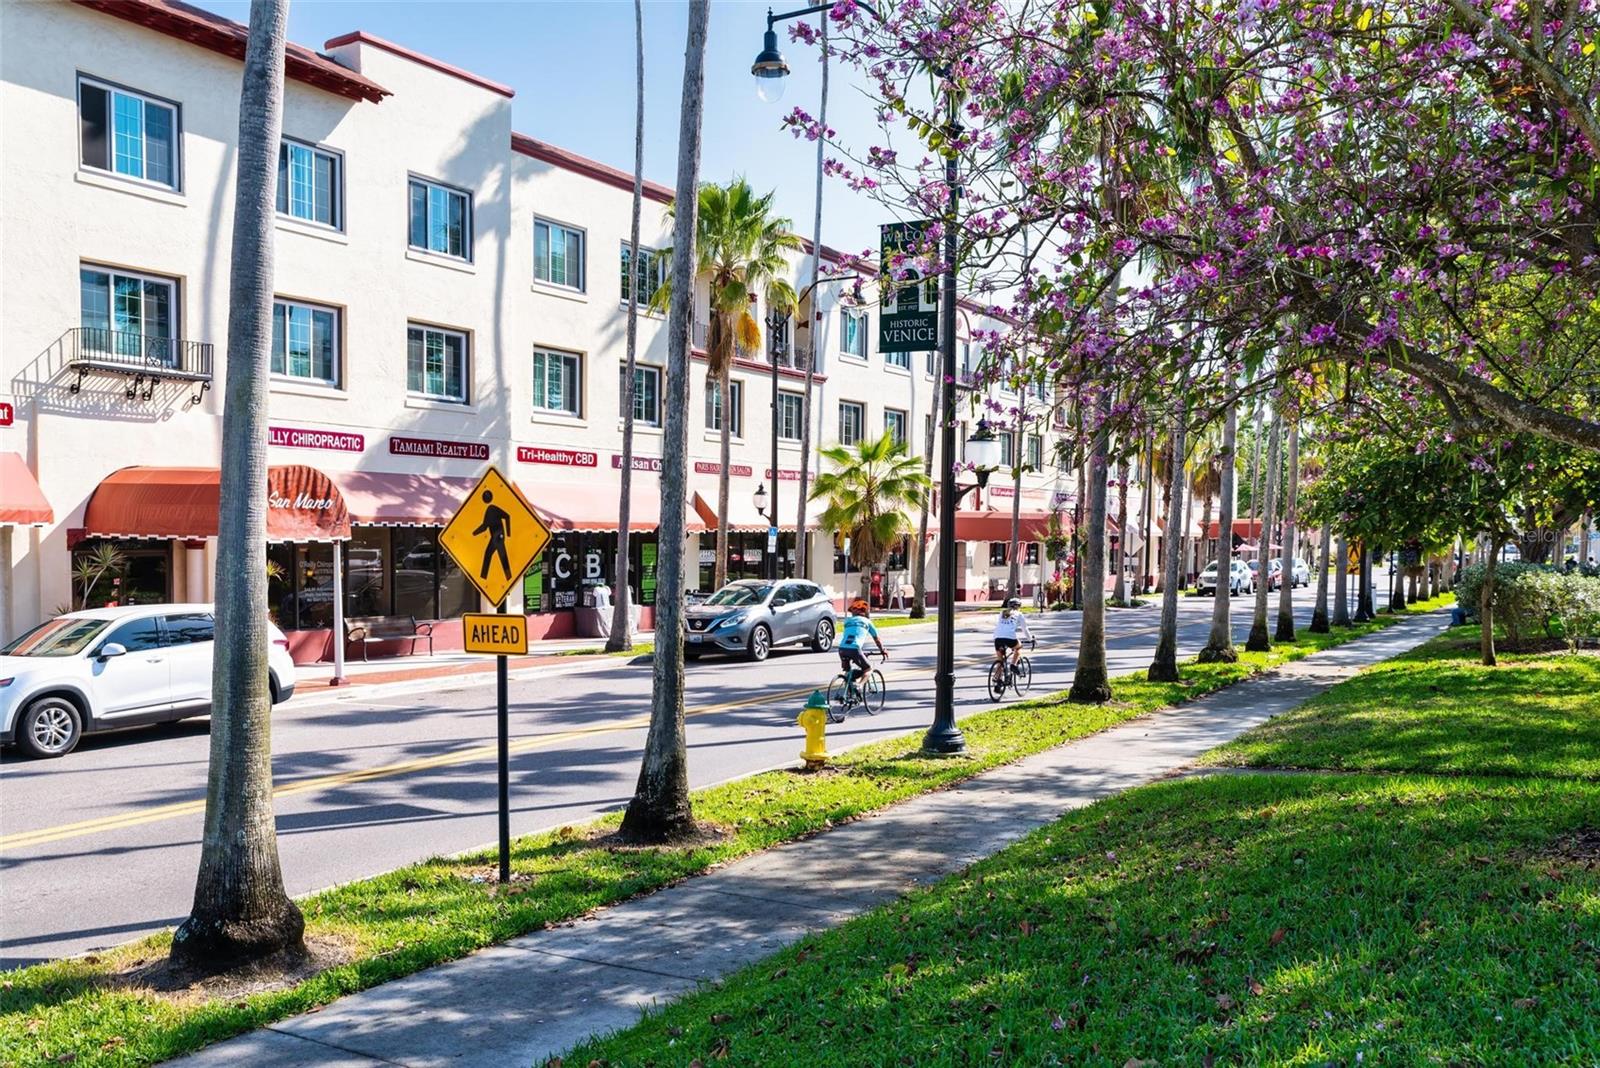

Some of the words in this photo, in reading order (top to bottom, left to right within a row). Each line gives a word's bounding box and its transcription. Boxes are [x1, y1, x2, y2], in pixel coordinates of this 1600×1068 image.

[890, 319, 929, 328] HISTORIC
[883, 328, 935, 342] VENICE
[268, 430, 290, 444] ILLY
[291, 432, 361, 449] CHIROPRACTIC
[392, 439, 434, 454] TAMIAMI
[436, 442, 468, 457] REALTY
[469, 445, 486, 457] LLC
[520, 449, 574, 465] Tri-Healthy
[575, 452, 594, 465] CBD
[617, 457, 649, 470] Aisan
[651, 459, 663, 471] Ch
[268, 490, 290, 508] San
[292, 492, 333, 510] Marco
[555, 553, 571, 579] C
[586, 554, 601, 578] B
[472, 624, 520, 644] AHEAD
